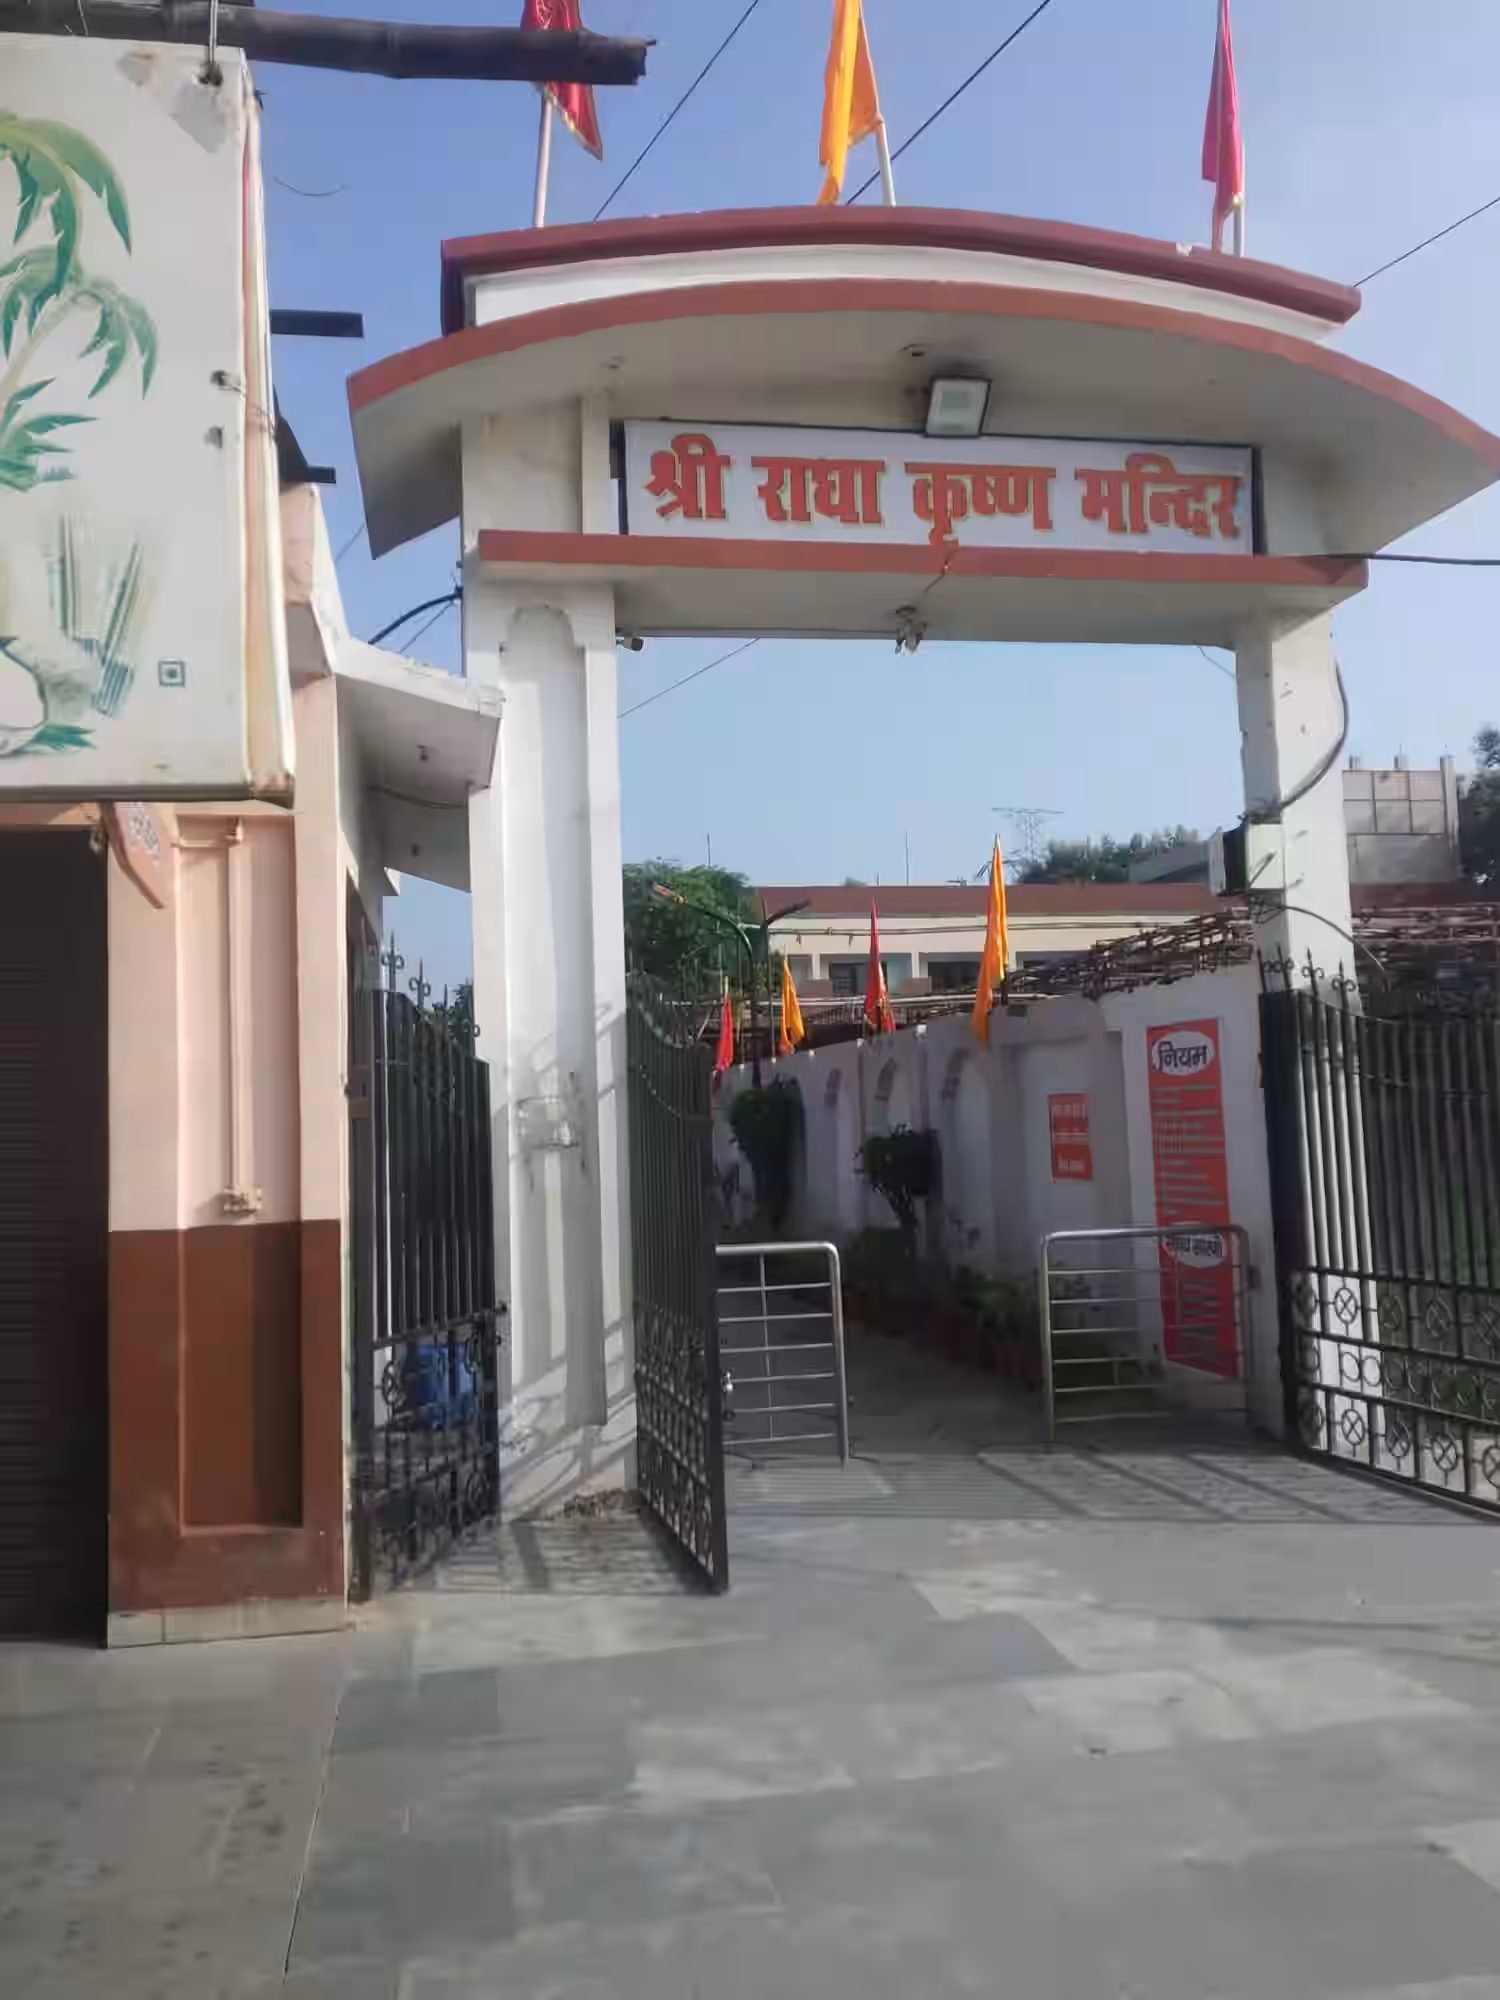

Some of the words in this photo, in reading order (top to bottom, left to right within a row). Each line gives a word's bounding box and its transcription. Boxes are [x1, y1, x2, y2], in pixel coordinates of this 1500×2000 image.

[644, 433, 731, 520] श्री
[904, 461, 1057, 549] कृष्ण
[1158, 1041, 1207, 1072] नियम
